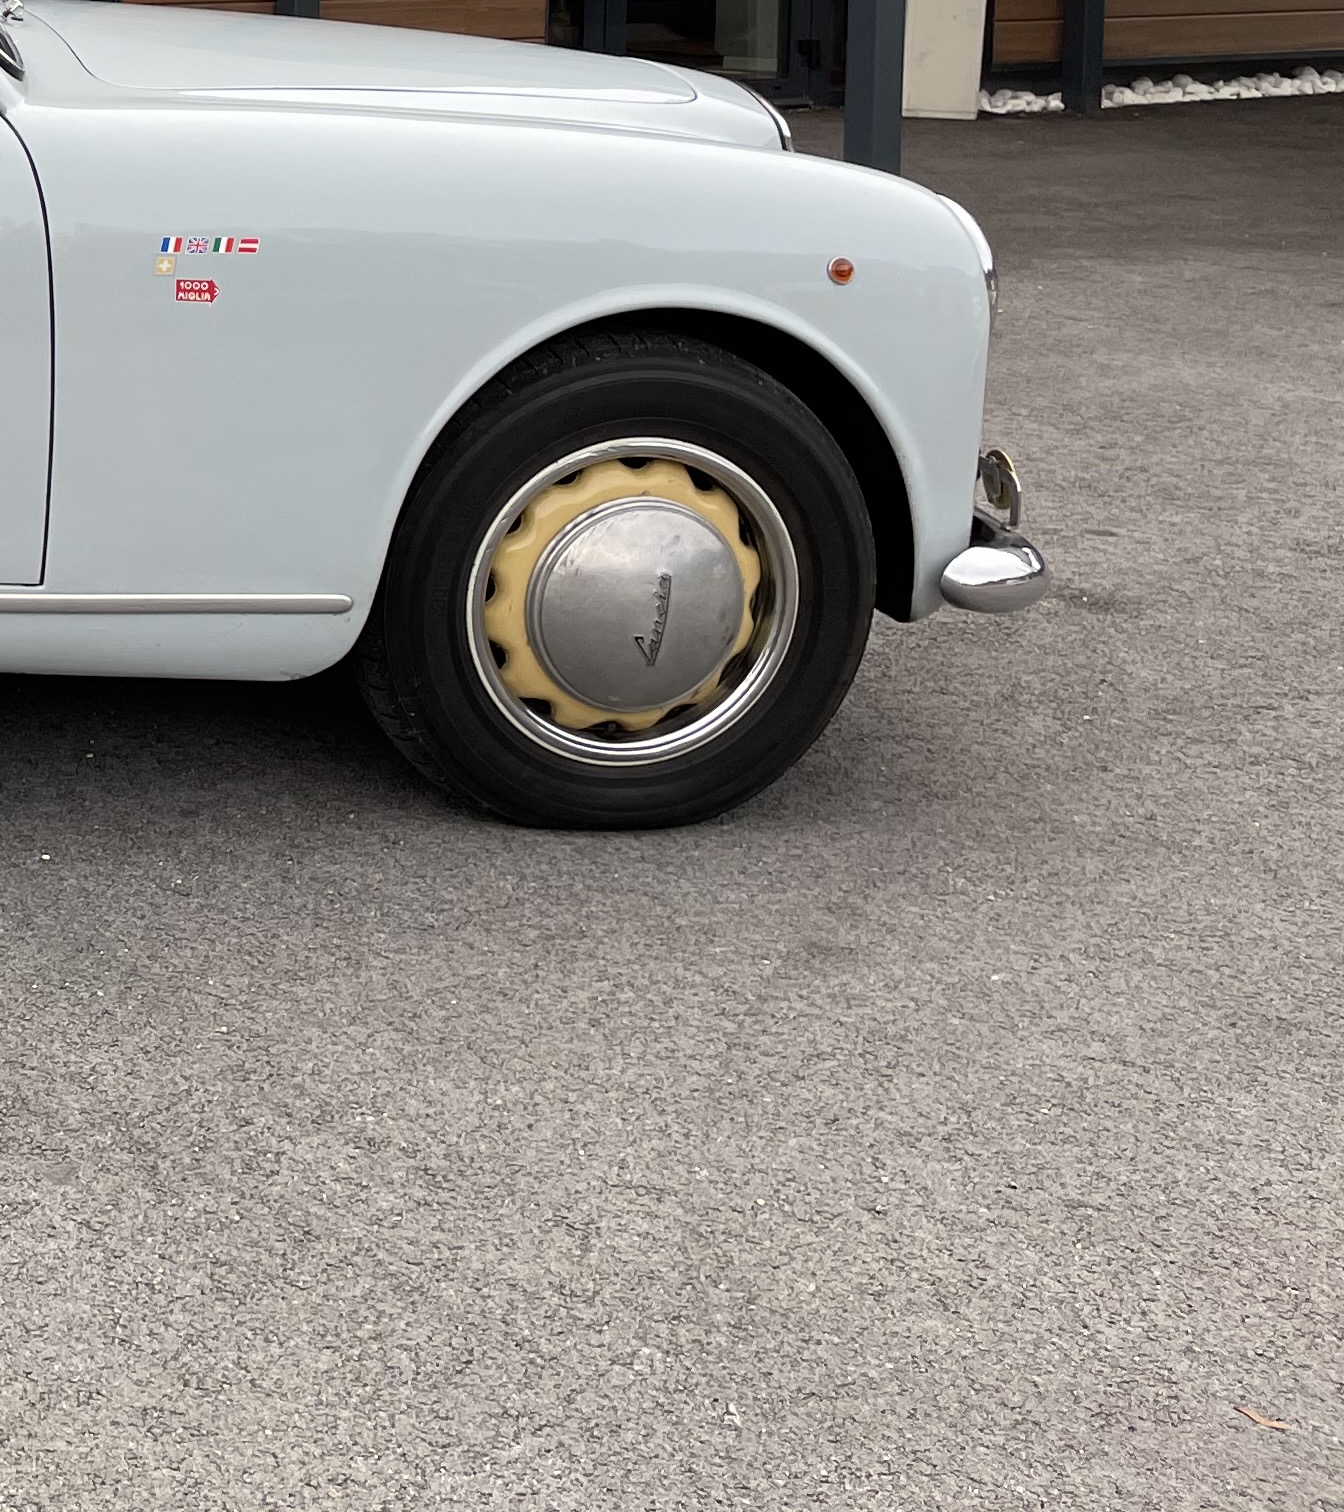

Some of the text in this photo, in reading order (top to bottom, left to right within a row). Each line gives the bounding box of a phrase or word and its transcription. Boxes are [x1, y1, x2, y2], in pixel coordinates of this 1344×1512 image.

[179, 280, 209, 291] 1000
[177, 291, 212, 301] MIGLIA
[634, 573, 672, 667] Lancia
